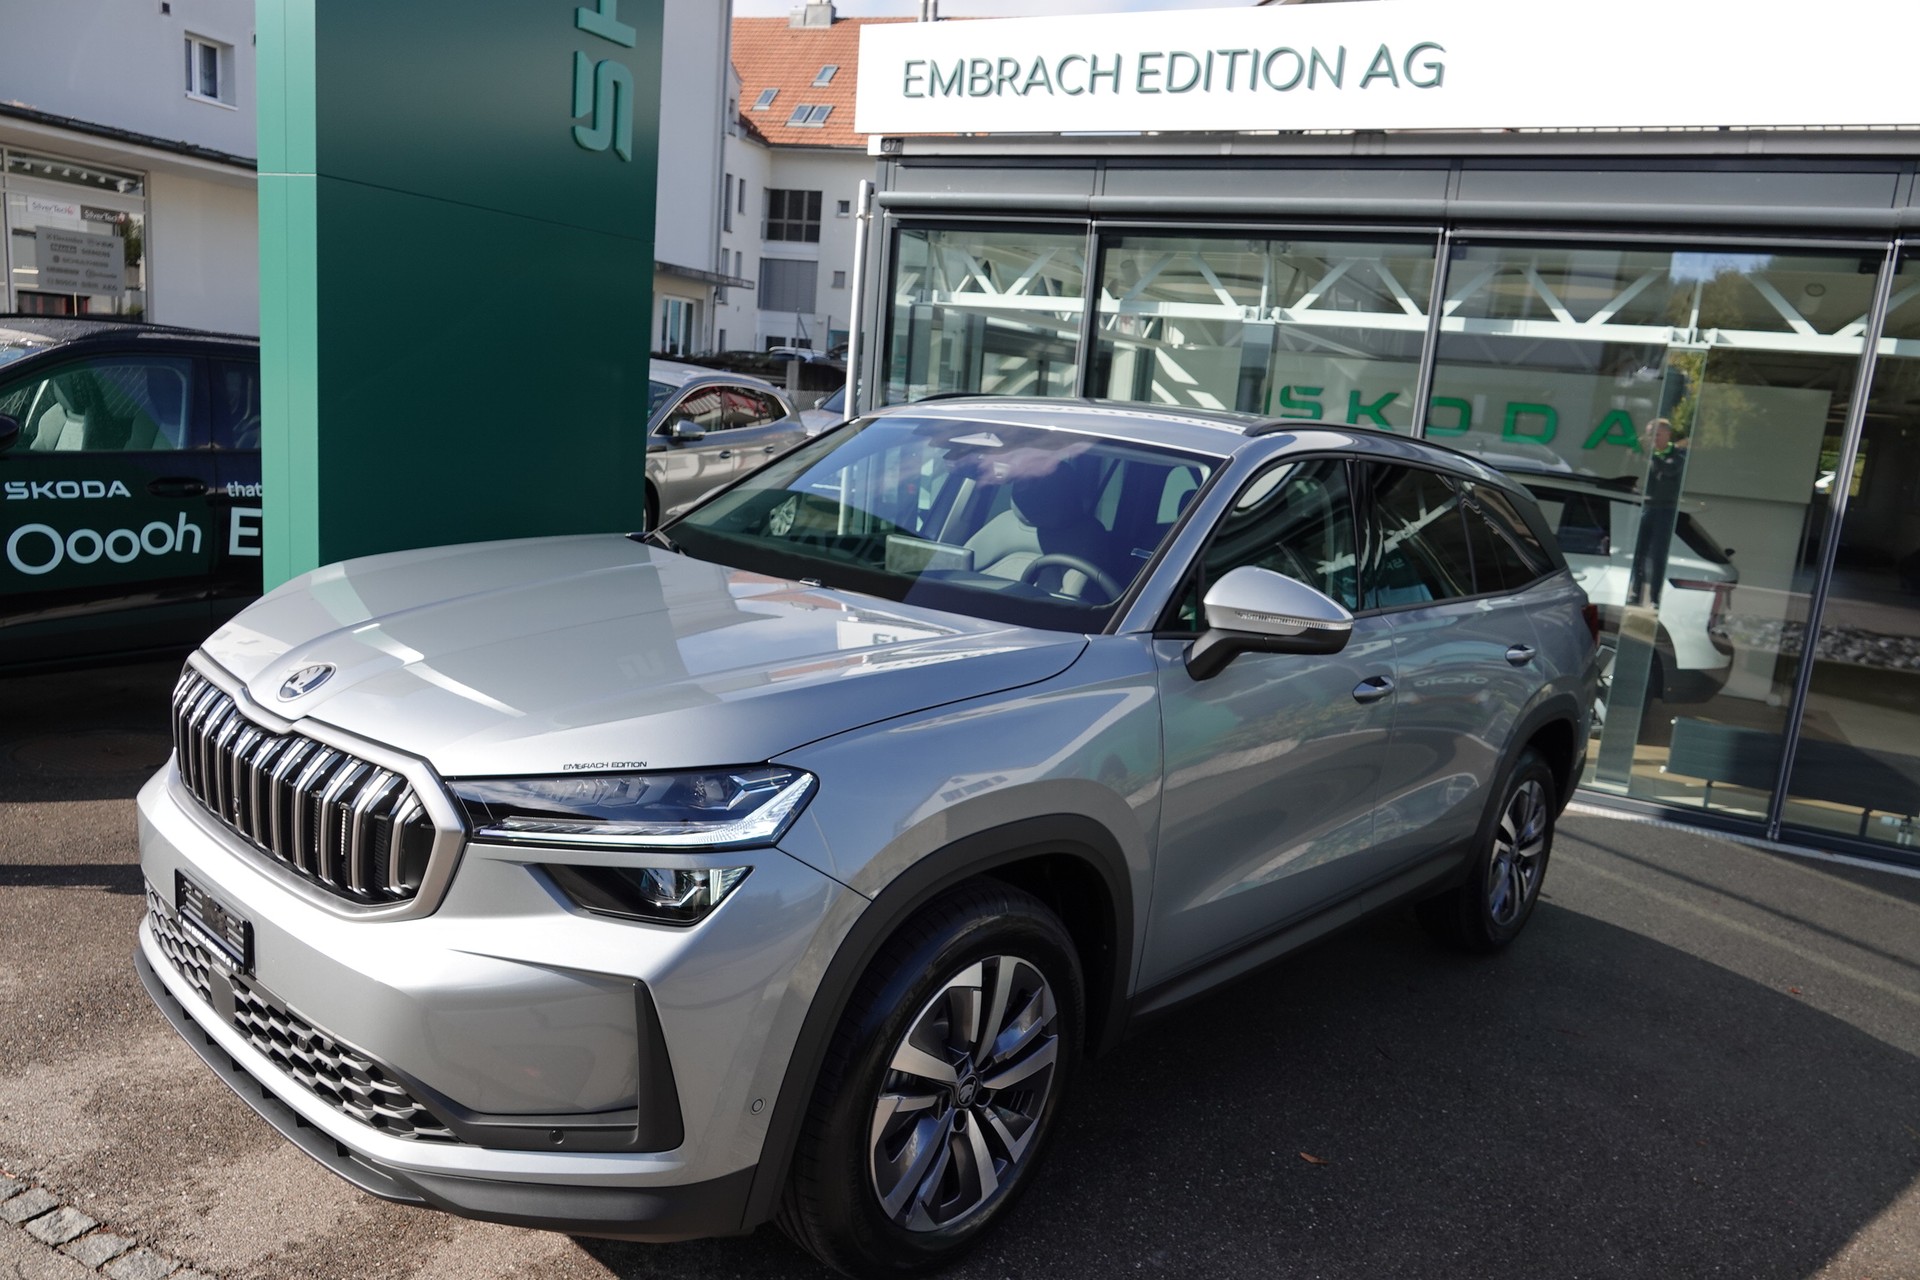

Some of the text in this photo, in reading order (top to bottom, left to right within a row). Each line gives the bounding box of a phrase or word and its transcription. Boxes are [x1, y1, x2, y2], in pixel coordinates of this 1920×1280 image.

[902, 40, 1447, 98] EMBRACH EDITION AG
[1279, 385, 1645, 453] SKODA
[4, 480, 132, 500] SKODA
[6, 511, 202, 575] Ooooh
[562, 762, 609, 771] EMBRACH
